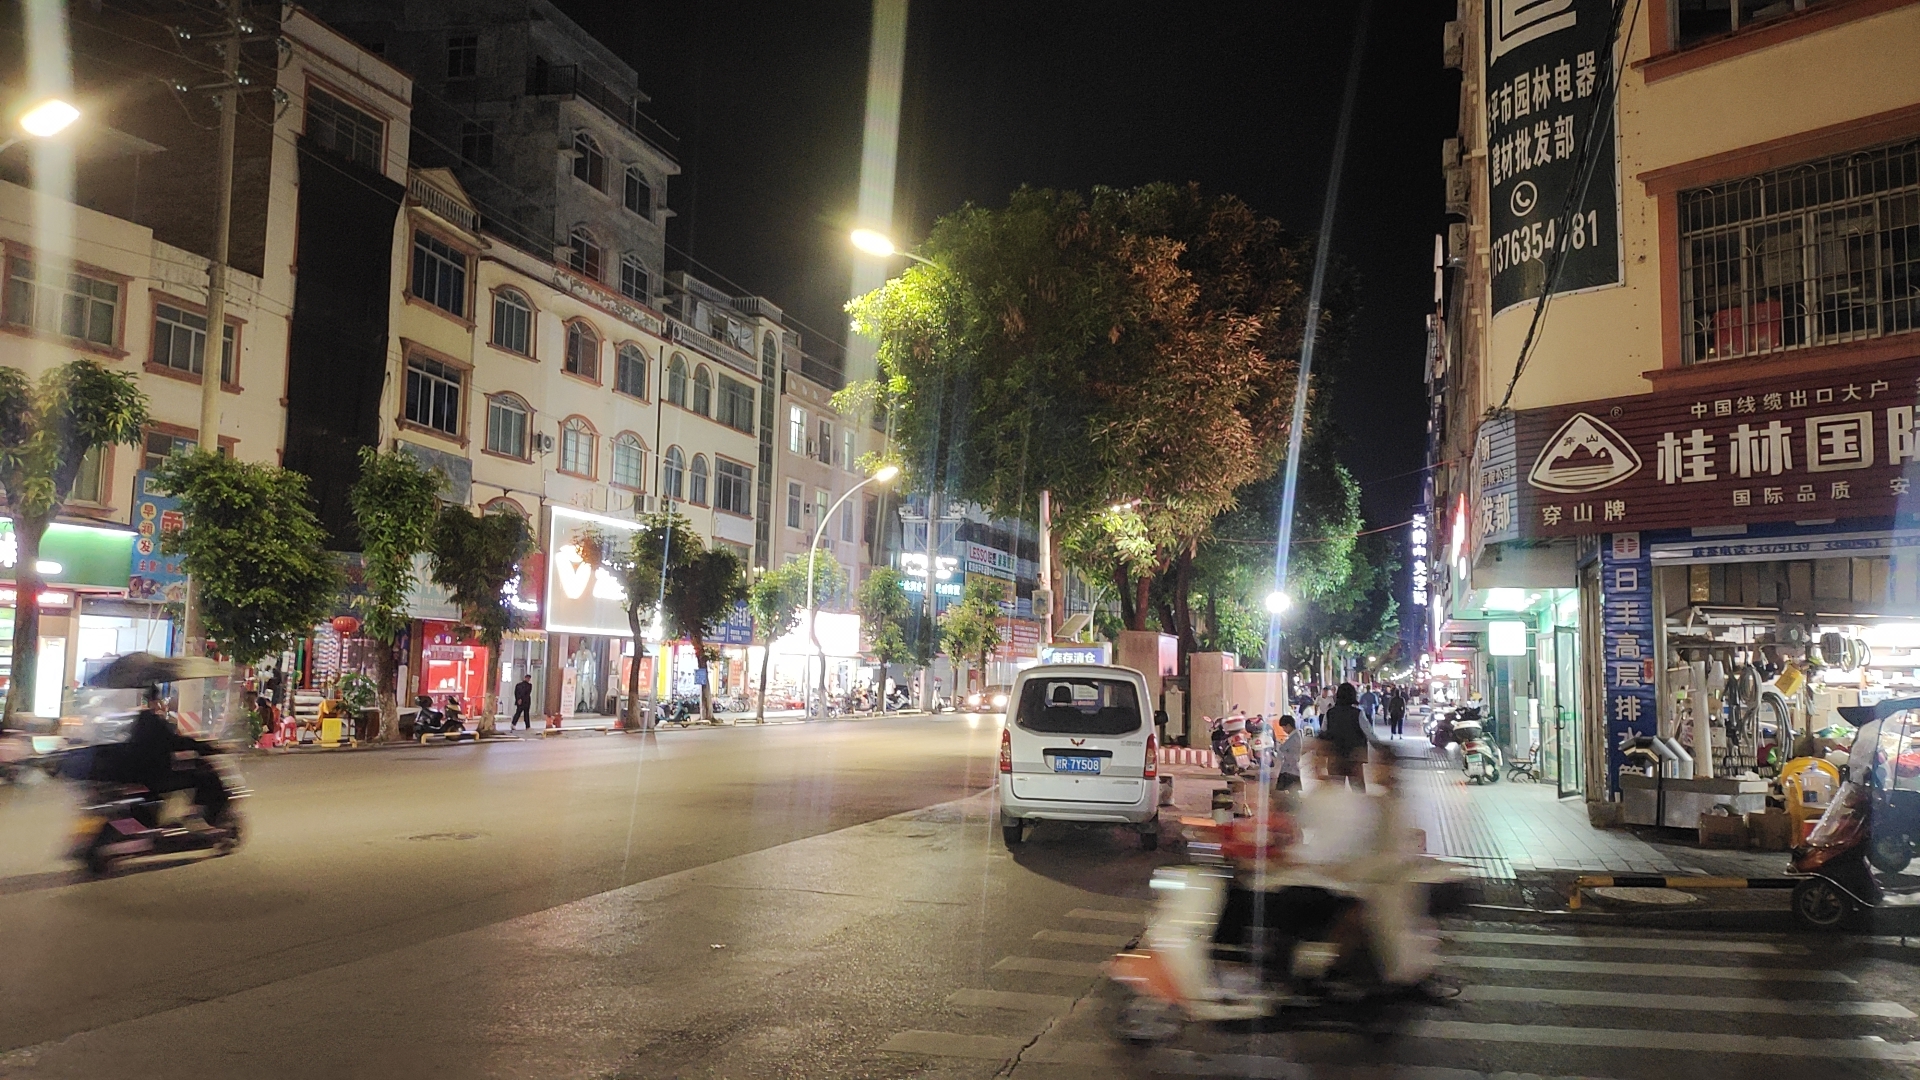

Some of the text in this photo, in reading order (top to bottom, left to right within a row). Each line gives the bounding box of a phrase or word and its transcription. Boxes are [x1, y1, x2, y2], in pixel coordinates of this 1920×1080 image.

[1488, 50, 1597, 140] 平市园林电器
[1492, 115, 1575, 188] 建材批发部
[1690, 379, 1889, 420] 中国线缆出口大户
[1732, 476, 1911, 508] 国际品质 安
[1542, 499, 1627, 528] 穿山牌
[1051, 652, 1096, 664] 库存清仓
